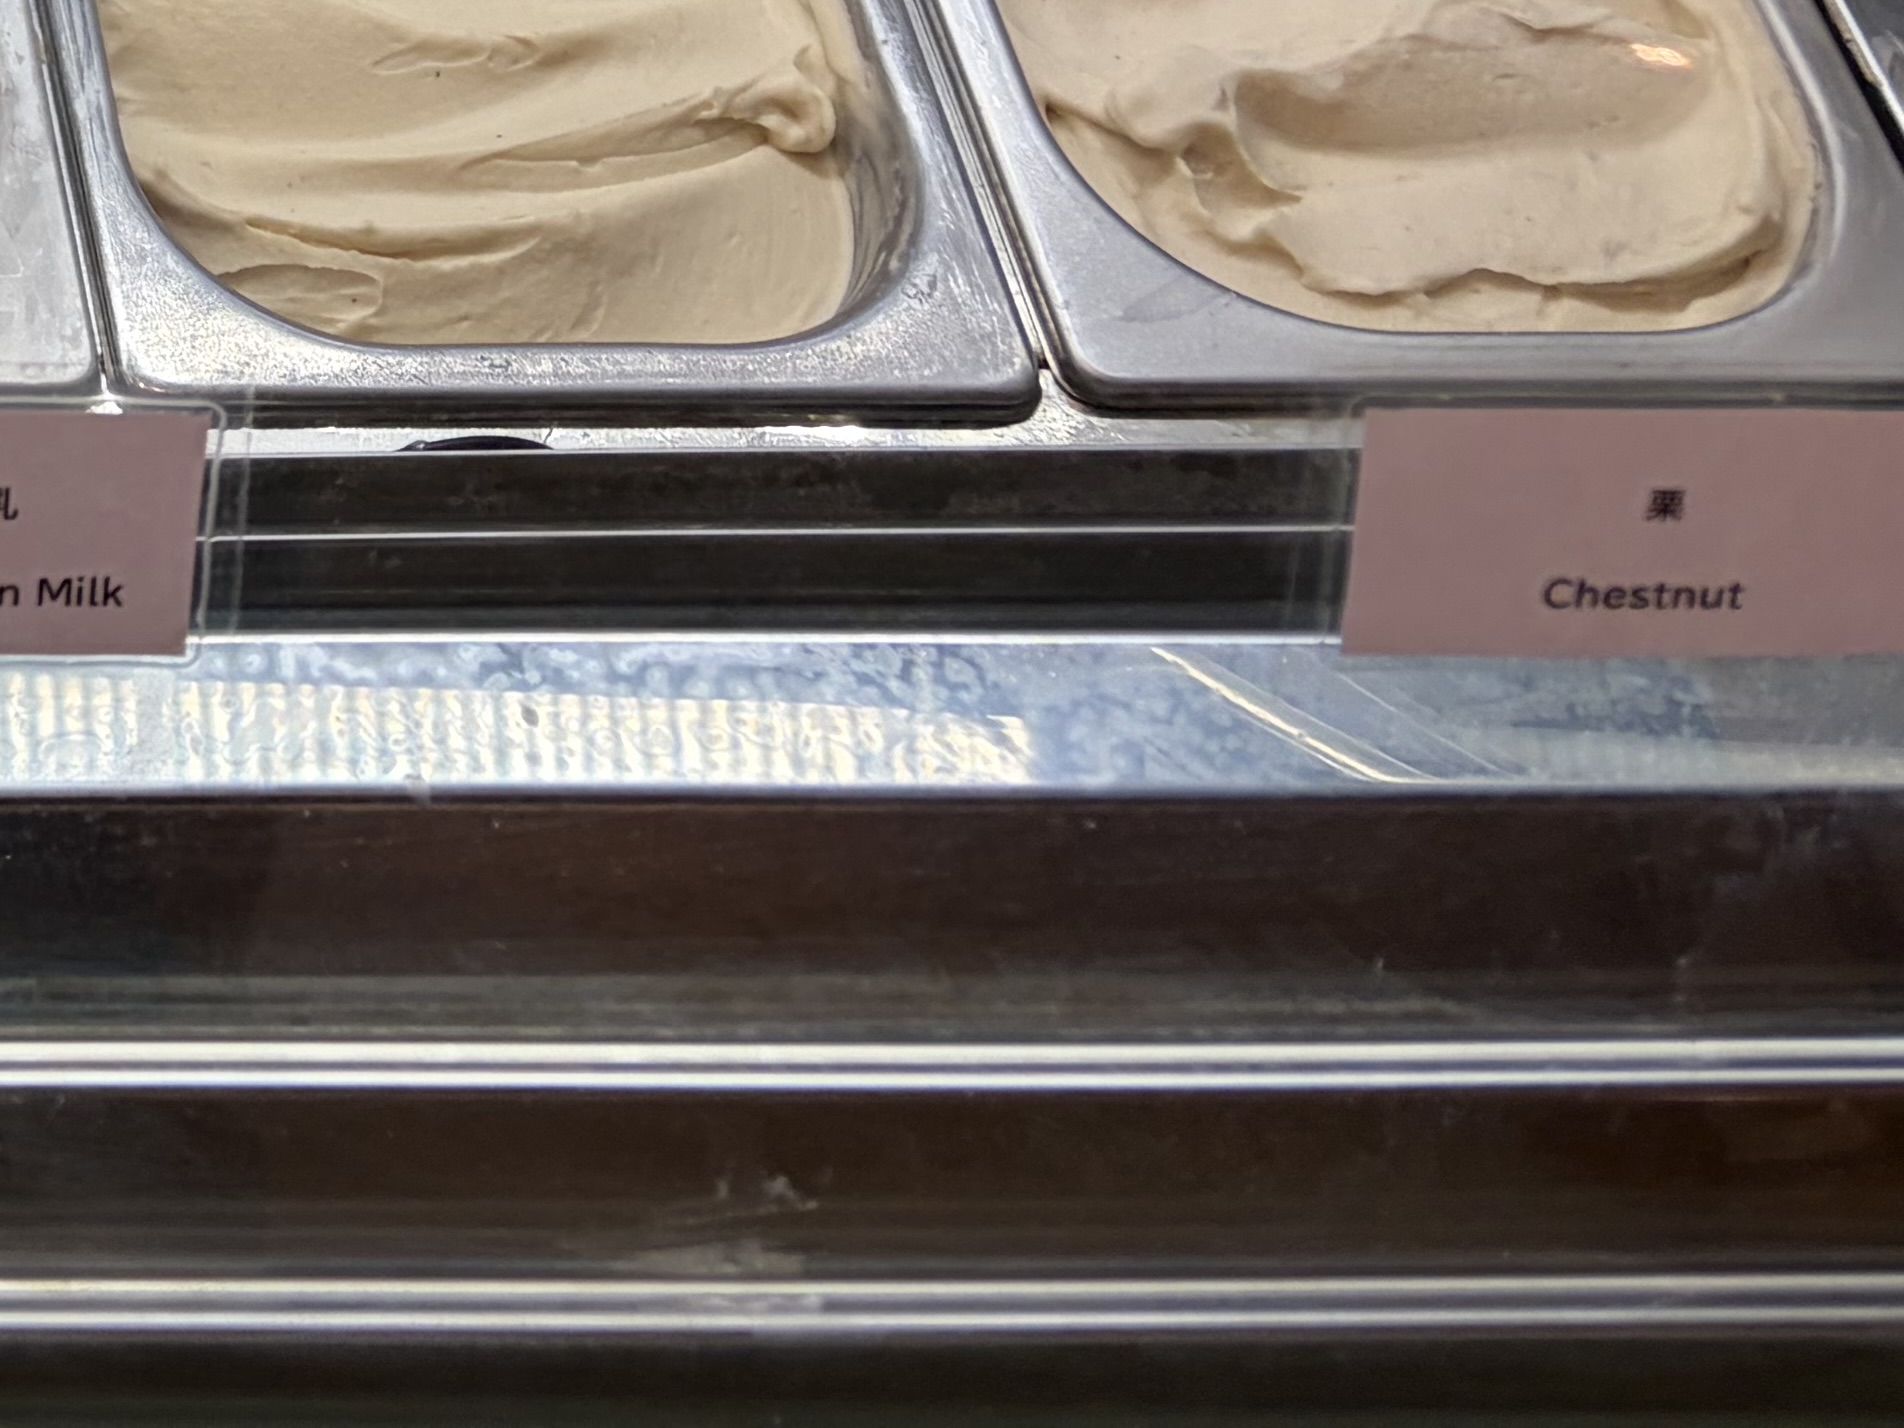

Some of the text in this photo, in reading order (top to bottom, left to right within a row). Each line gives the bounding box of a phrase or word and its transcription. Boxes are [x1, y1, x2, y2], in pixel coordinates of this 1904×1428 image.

[1644, 487, 1687, 523] 栗
[36, 575, 124, 608] Milk
[1541, 576, 1745, 611] Chestnut
